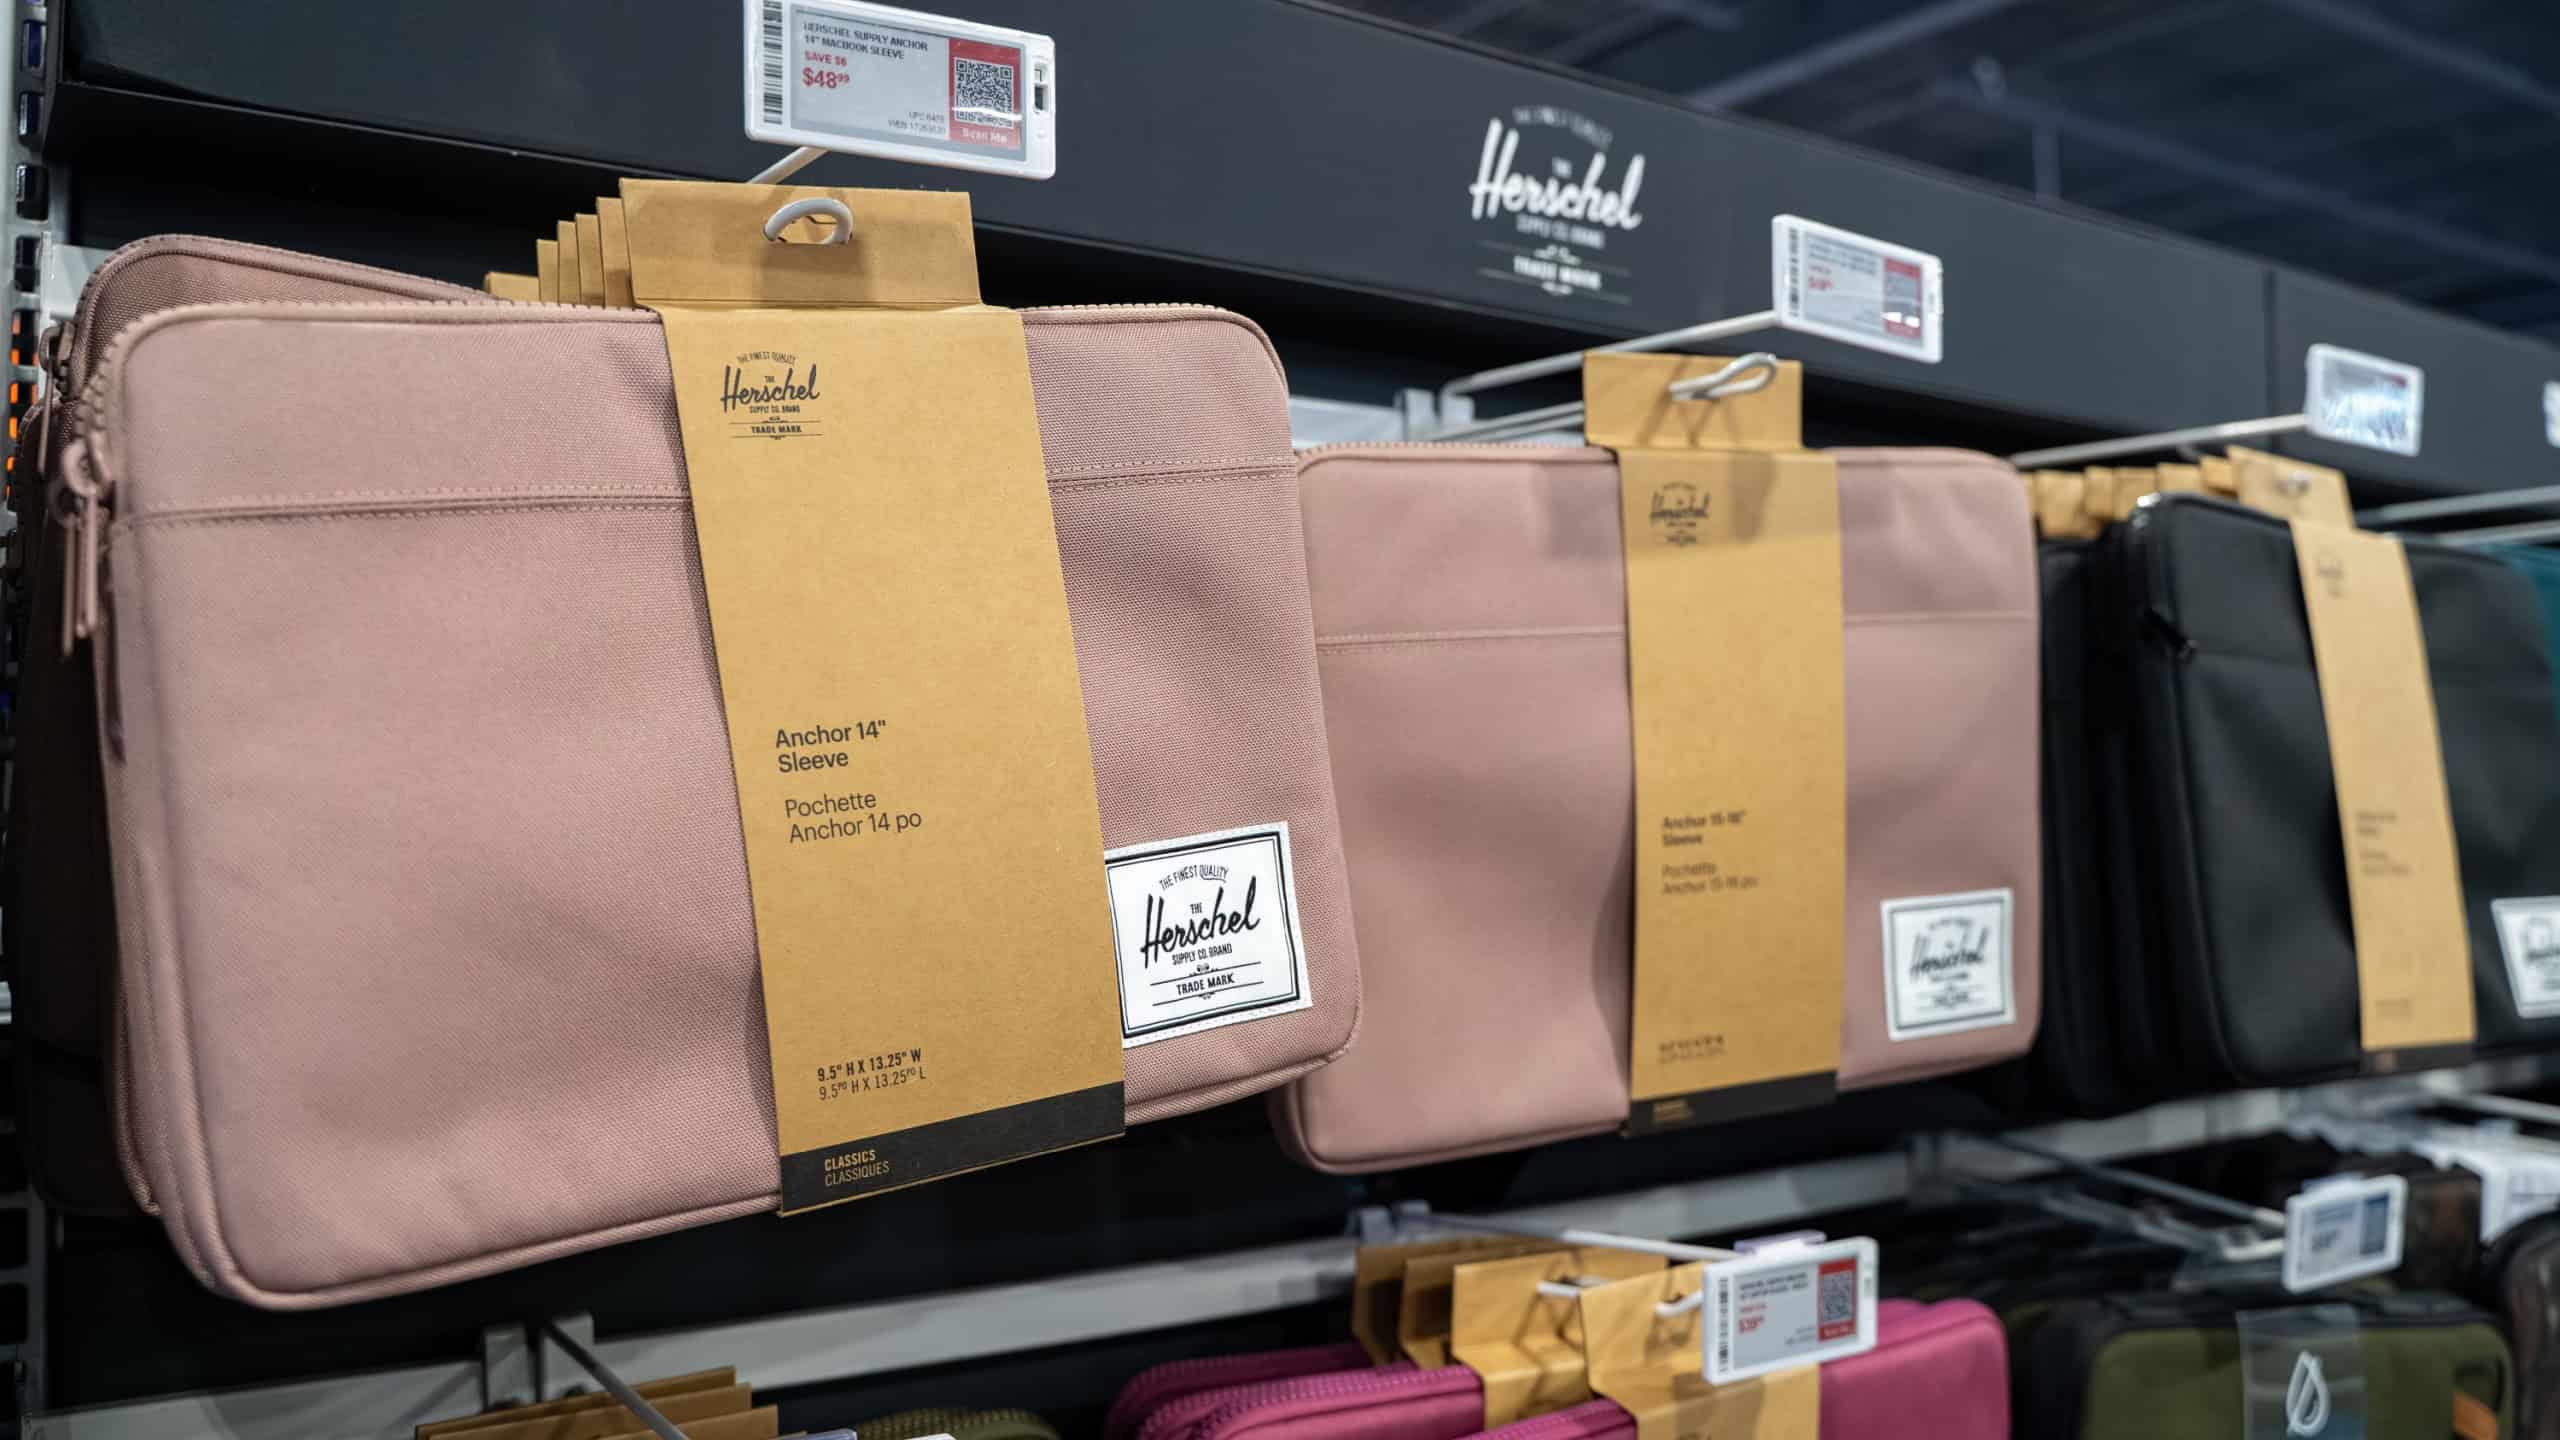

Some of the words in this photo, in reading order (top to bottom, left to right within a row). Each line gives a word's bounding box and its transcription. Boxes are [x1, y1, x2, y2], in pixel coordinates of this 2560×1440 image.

[804, 22, 849, 38] HERSCHEL
[854, 30, 888, 44] SUPPLY
[890, 37, 928, 51] ANCHOR
[822, 37, 868, 54] MACBOOK
[870, 46, 904, 60] SLEEVE
[804, 50, 832, 64] SAVE
[1468, 116, 1646, 230] Herschel
[720, 363, 820, 413] Herschel
[775, 724, 852, 748] Anchor
[856, 719, 886, 740] 14"
[778, 751, 849, 773] Sleeve
[785, 792, 877, 818] Pochette
[789, 818, 864, 844] Anchor
[868, 812, 890, 832] 14
[895, 812, 922, 833] po
[1159, 875, 1174, 890] THE
[1173, 864, 1197, 883] FINEST
[1199, 864, 1229, 884] QUALITY
[1190, 902, 1202, 914] THE
[1139, 875, 1262, 969] Herschel
[1172, 949, 1195, 965] SUPPLY
[1208, 943, 1233, 957] BRAND
[1176, 980, 1205, 996] TRADE
[1207, 971, 1235, 988] MARK
[846, 1062, 855, 1076] H
[858, 1059, 866, 1073] X
[910, 1047, 921, 1063] W
[851, 1080, 859, 1094] H
[863, 1077, 871, 1091] X
[919, 1066, 926, 1080] L
[824, 1149, 876, 1172] CLASSICS
[825, 1161, 890, 1187] CLASSIQUES
